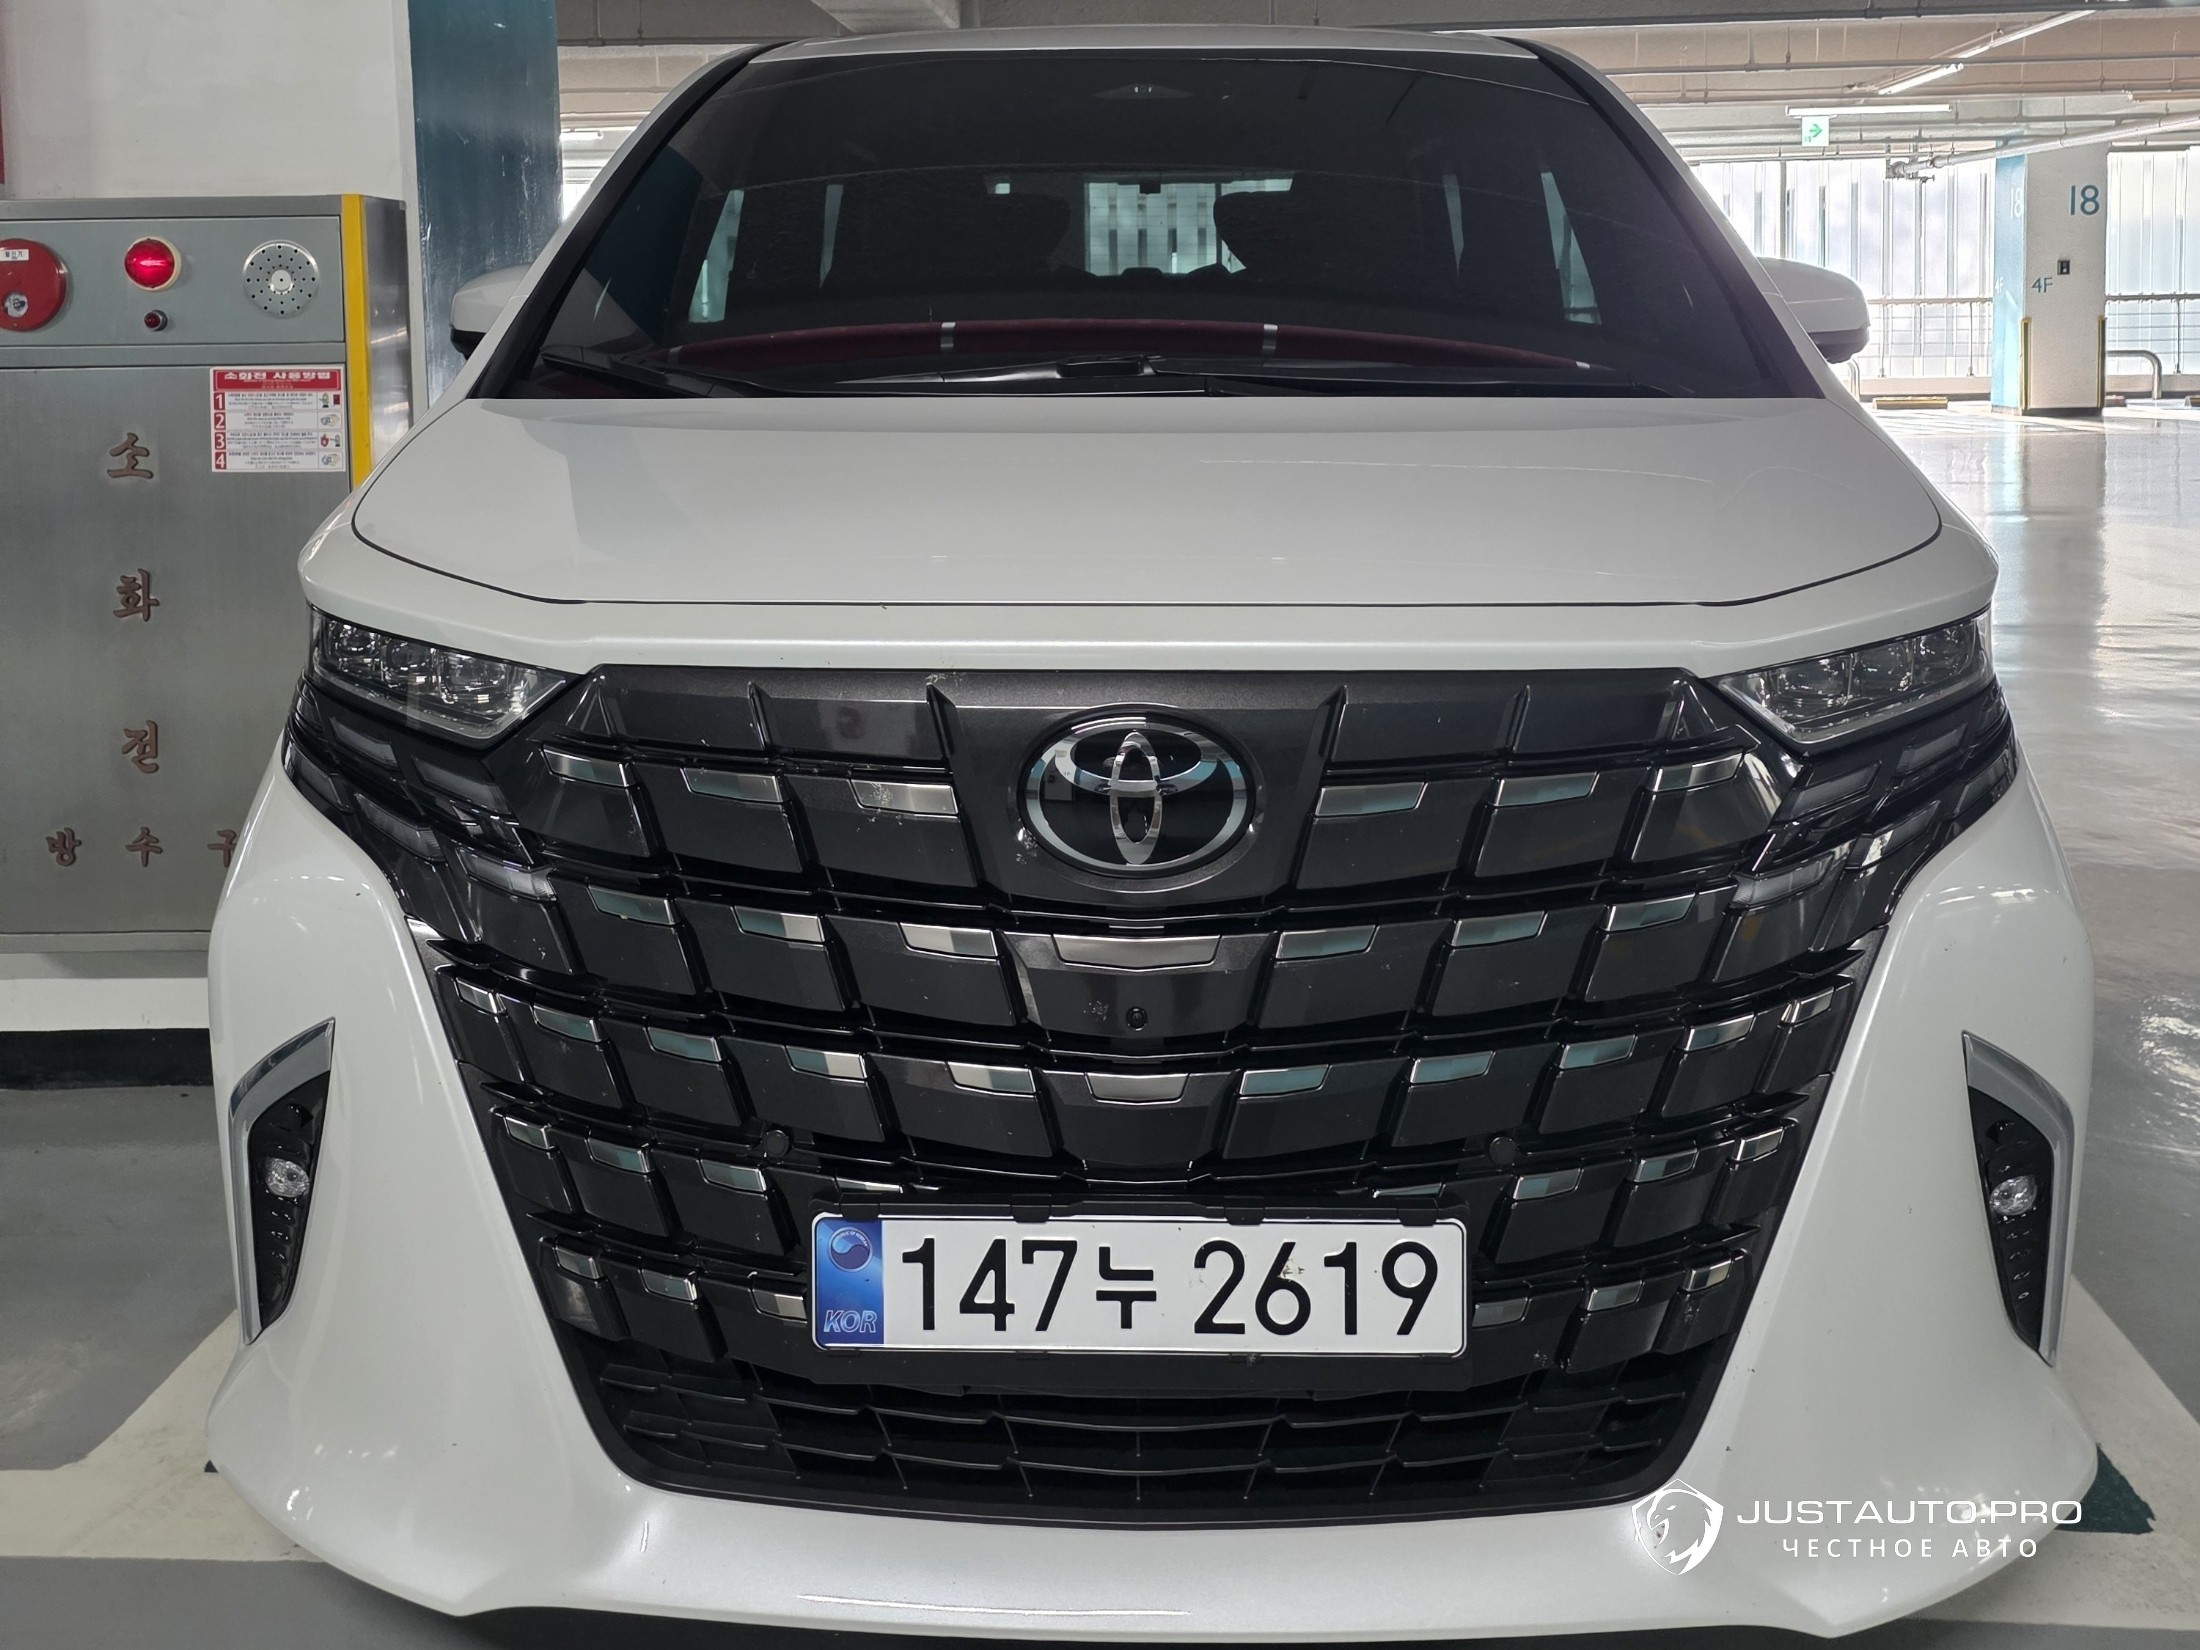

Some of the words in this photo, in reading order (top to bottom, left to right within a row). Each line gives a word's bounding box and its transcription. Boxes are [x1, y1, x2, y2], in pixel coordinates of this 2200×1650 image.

[2009, 186, 2024, 218] 18
[2070, 184, 2100, 216] 18
[2032, 276, 2053, 293] 4F
[224, 371, 267, 379] 소화전
[273, 371, 331, 379] 사용방법
[215, 393, 223, 410] 1
[215, 413, 225, 429] 2
[216, 433, 225, 449] 3
[215, 453, 226, 469] 4
[901, 1237, 1157, 1333] 147누
[1193, 1240, 1439, 1336] 2619
[823, 1309, 878, 1333] KOR
